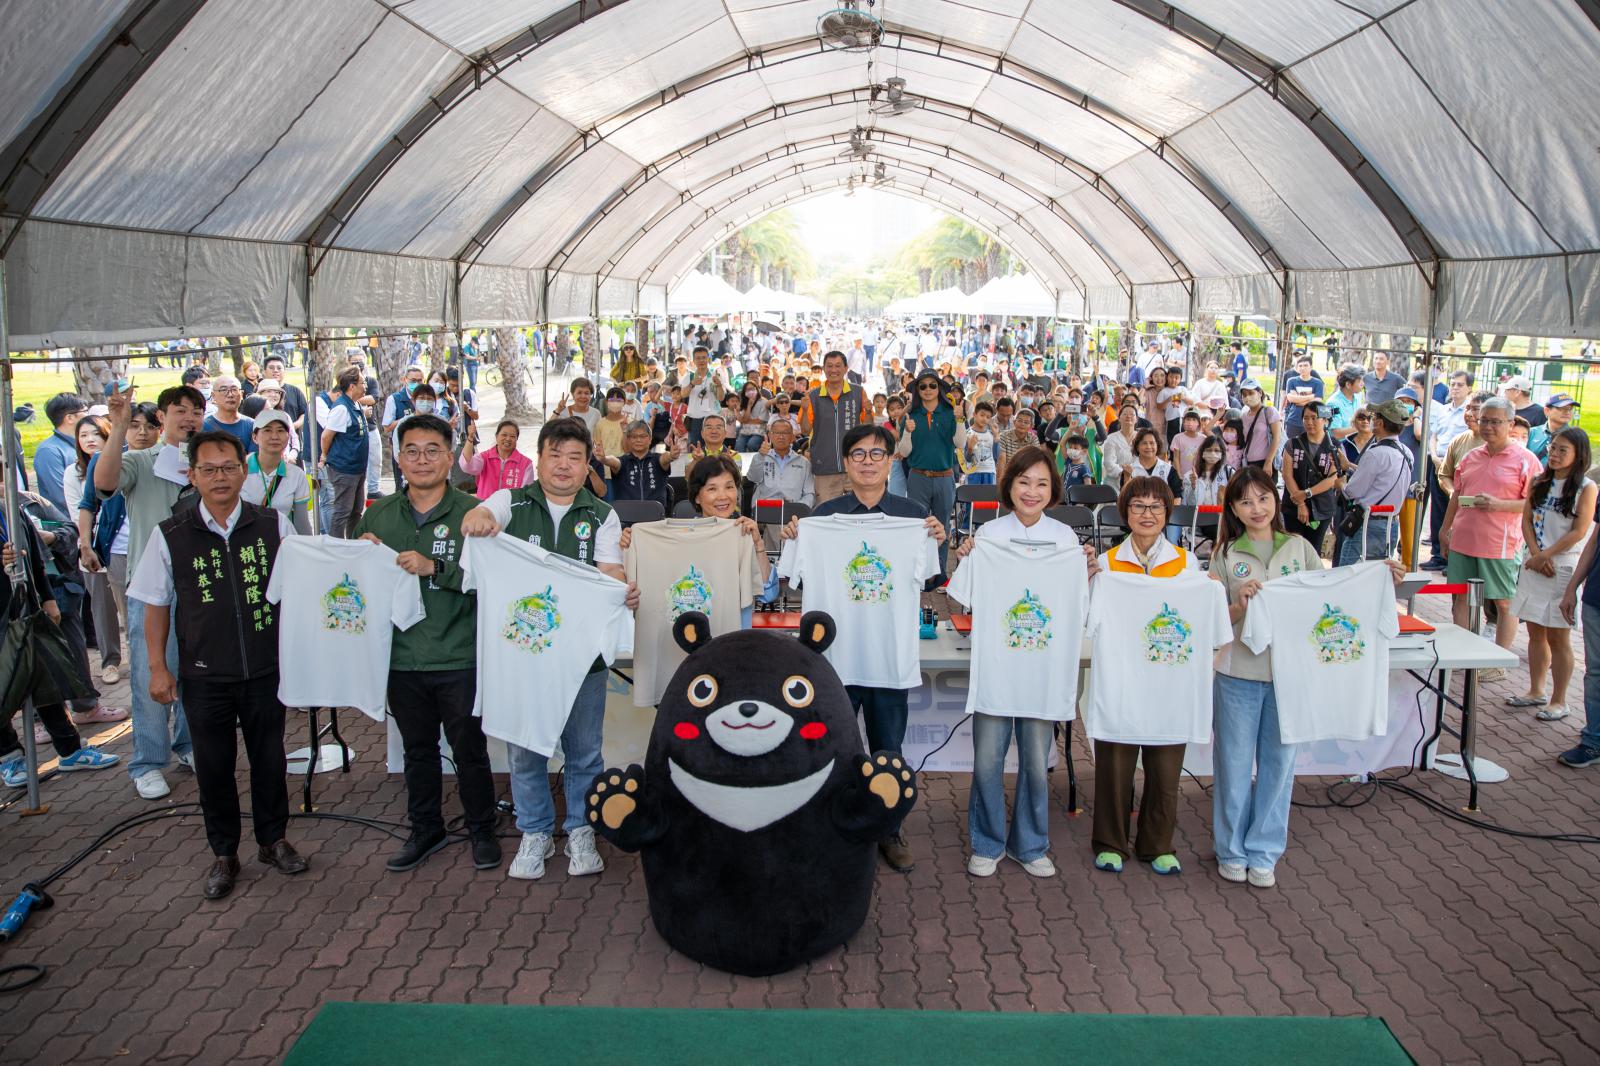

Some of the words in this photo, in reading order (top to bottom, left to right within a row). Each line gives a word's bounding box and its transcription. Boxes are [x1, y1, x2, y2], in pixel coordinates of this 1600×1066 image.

[210, 548, 224, 579] 執行長
[256, 537, 268, 577] 立法委員
[239, 545, 262, 605] 賴瑞隆
[253, 609, 265, 631] 團隊
